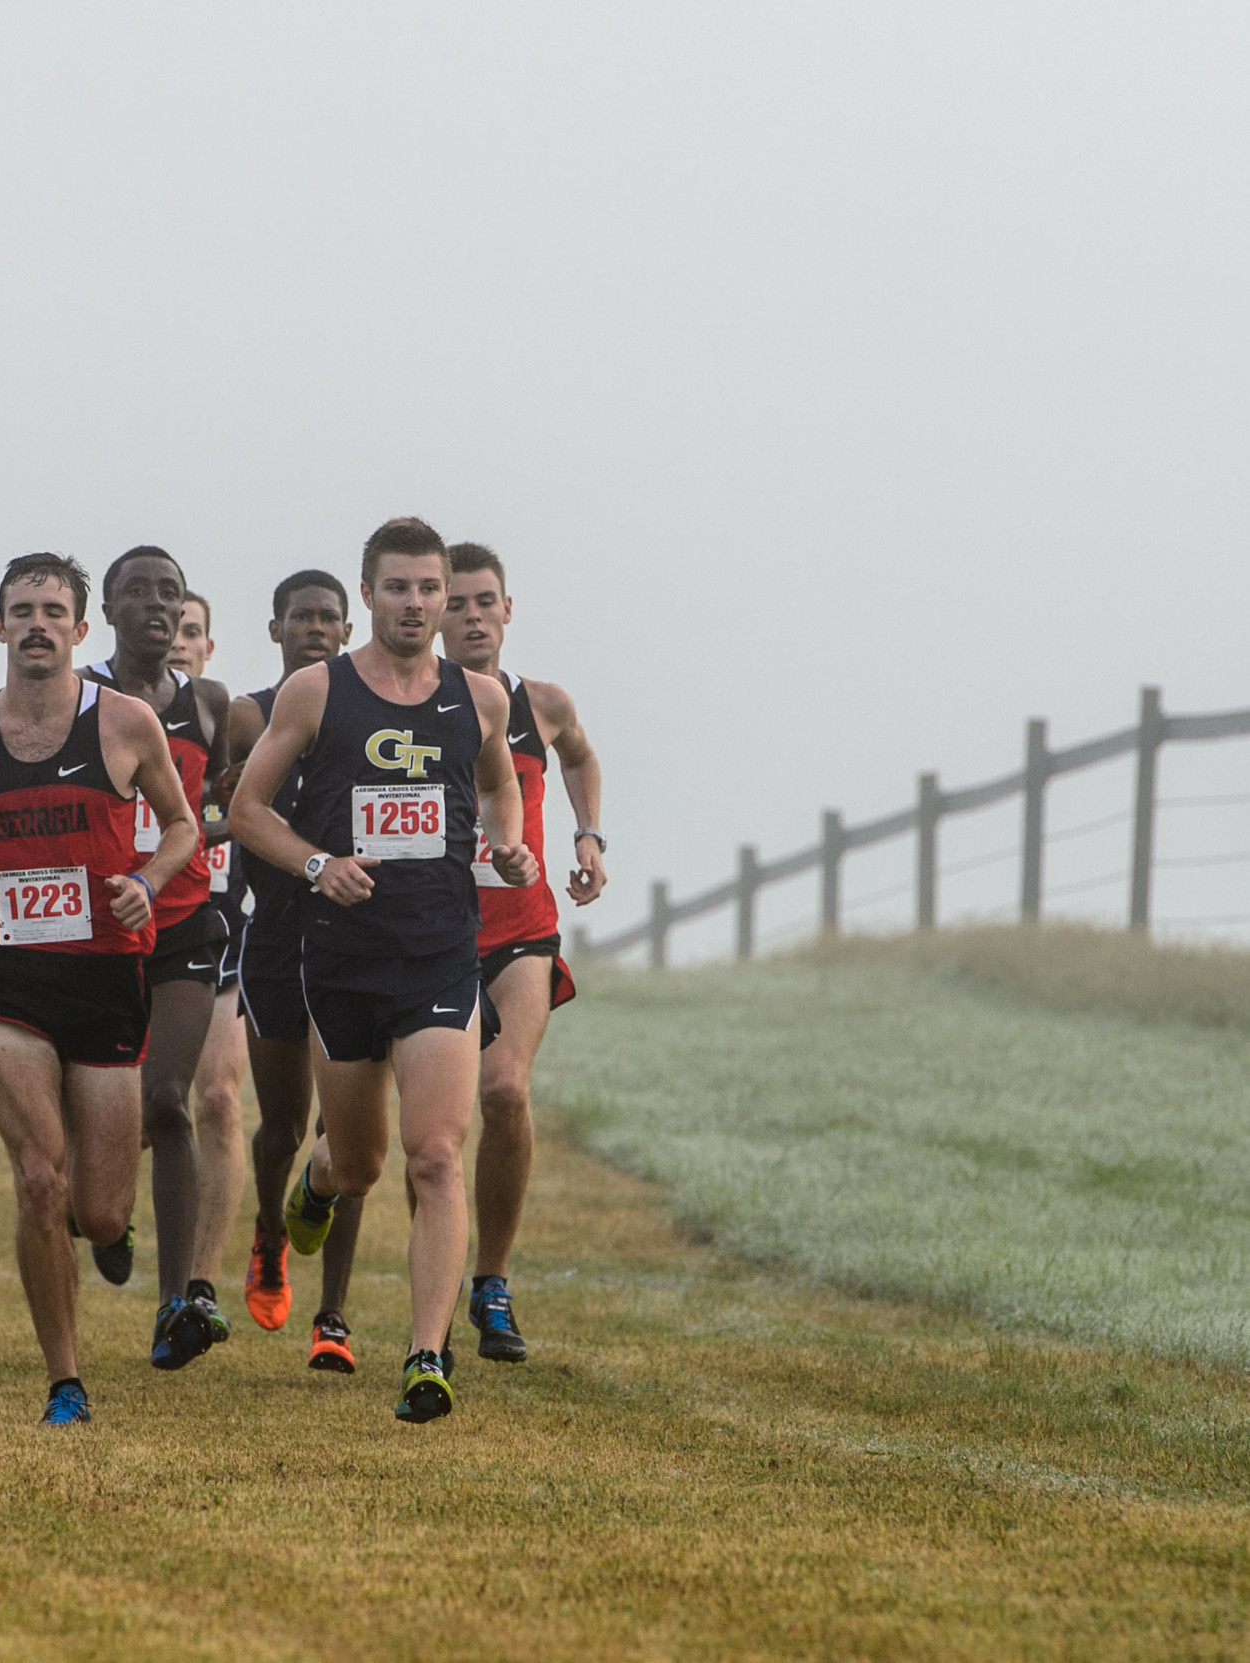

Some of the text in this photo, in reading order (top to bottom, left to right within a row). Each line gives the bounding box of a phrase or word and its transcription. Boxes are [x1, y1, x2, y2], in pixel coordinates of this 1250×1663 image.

[365, 728, 442, 778] GT
[361, 800, 439, 835] 1253
[18, 874, 61, 883] INVITATIONAL
[27, 869, 48, 877] CROSS
[49, 867, 79, 875] COUNTRY
[5, 881, 83, 921] 1223
